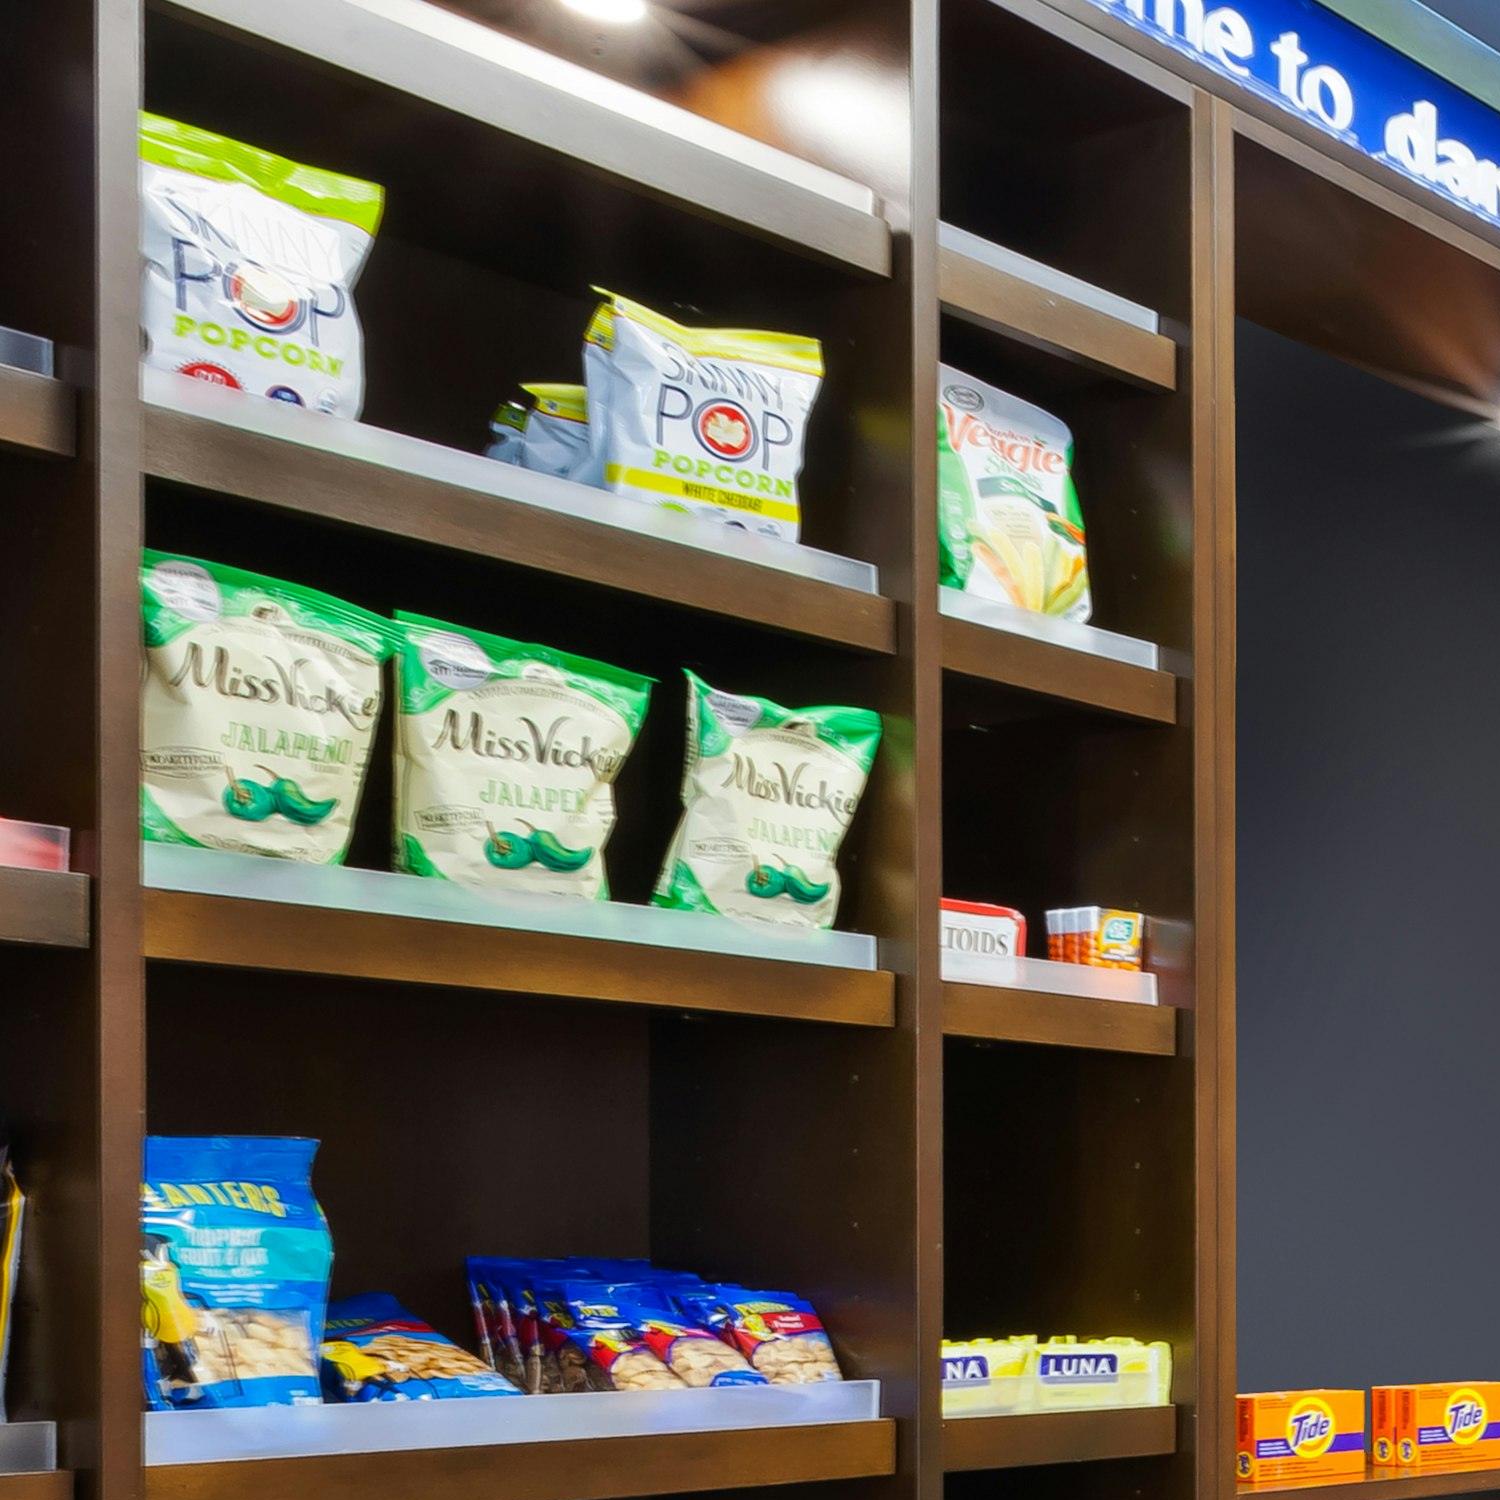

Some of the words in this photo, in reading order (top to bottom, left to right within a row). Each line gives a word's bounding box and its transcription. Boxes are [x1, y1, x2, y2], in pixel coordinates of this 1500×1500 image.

[1270, 31, 1355, 131] to
[172, 237, 344, 347] POP
[172, 314, 344, 380] POPCORN
[661, 342, 784, 411] SKINNY
[655, 383, 792, 471] POP
[940, 402, 1070, 474] Veggie
[652, 449, 794, 498] POPCORN
[169, 641, 280, 705] Miss
[432, 709, 533, 762] Miss
[721, 752, 782, 802] Miss
[942, 926, 1009, 956] TOIDS
[141, 1182, 287, 1218] LANTERS
[946, 1359, 983, 1381] NA
[1048, 1357, 1112, 1376] LUNA
[1290, 1411, 1331, 1448] Tide
[1447, 1402, 1483, 1437] Tide
